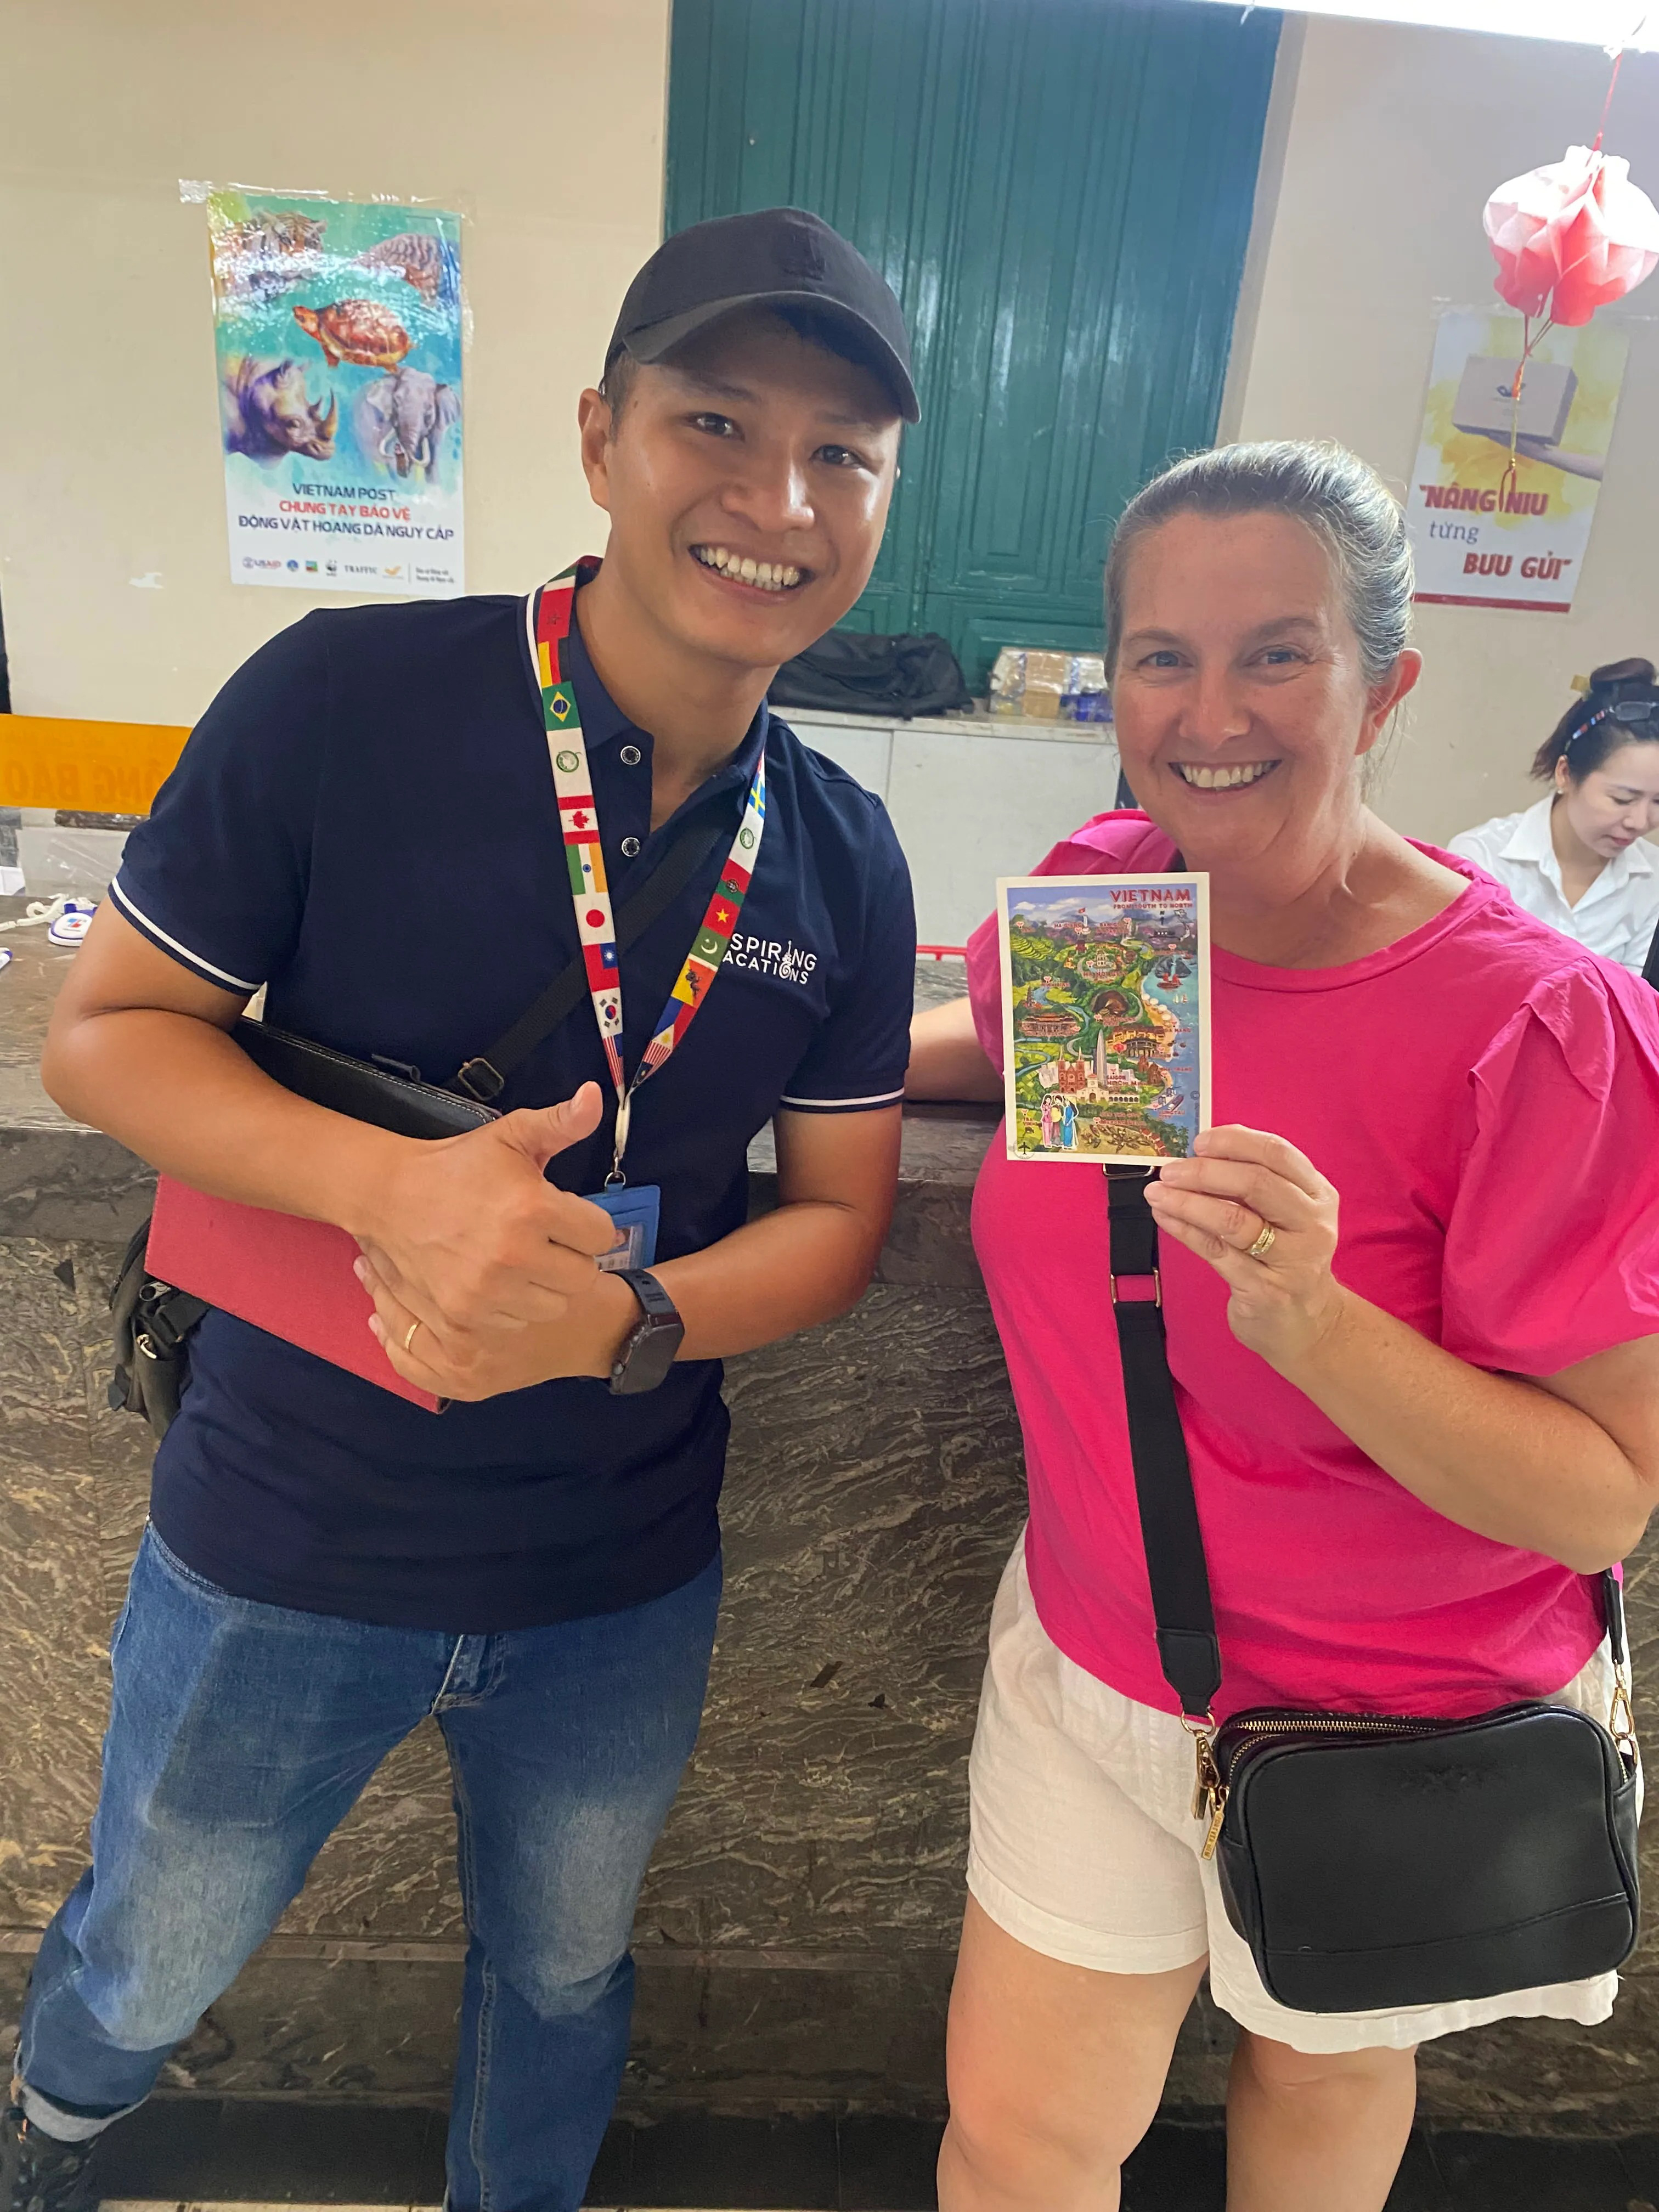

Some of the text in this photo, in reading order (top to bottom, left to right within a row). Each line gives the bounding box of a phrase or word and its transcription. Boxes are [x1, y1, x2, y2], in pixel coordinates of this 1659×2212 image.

[292, 482, 396, 501] VIETNAM POST
[279, 500, 326, 515] CHUNG
[329, 503, 356, 517] TAY
[1505, 491, 1549, 516] NIU
[313, 521, 361, 534] HOANG
[386, 525, 423, 539] NGUY
[1430, 520, 1479, 544] từng
[344, 565, 377, 574] TRAFFIC
[1110, 888, 1191, 902] VIETNAM
